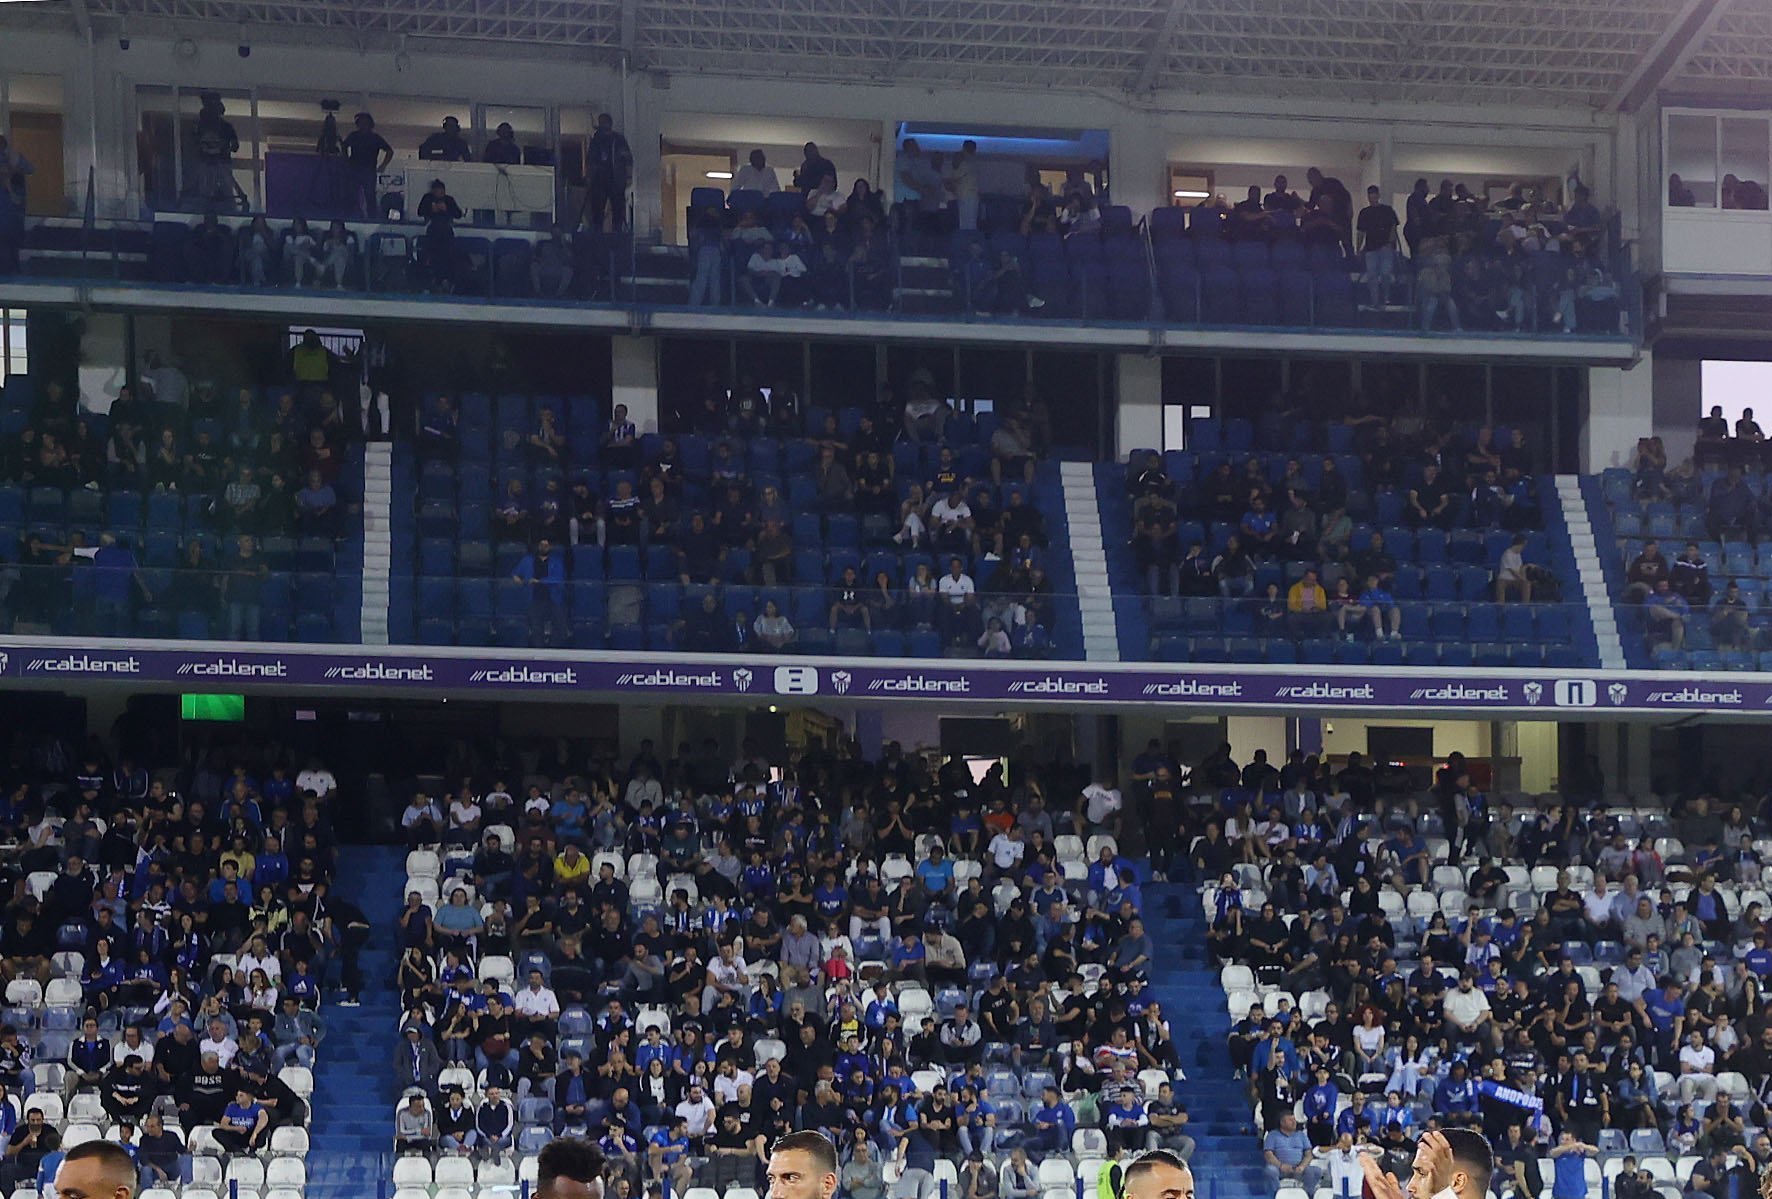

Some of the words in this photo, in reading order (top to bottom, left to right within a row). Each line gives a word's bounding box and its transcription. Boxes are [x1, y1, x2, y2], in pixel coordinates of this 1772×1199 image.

[44, 656, 139, 672] cablenet
[194, 660, 286, 676] cablenet
[342, 663, 432, 679] cablenet
[486, 667, 576, 683] cablenet
[633, 670, 721, 685] cablenet
[884, 676, 969, 691] cablenet
[1024, 678, 1108, 693] cablenet
[1158, 680, 1241, 695] cablenet
[1291, 683, 1373, 698] cablenet
[1426, 684, 1508, 699] cablenet
[1662, 688, 1742, 703] cablenet
